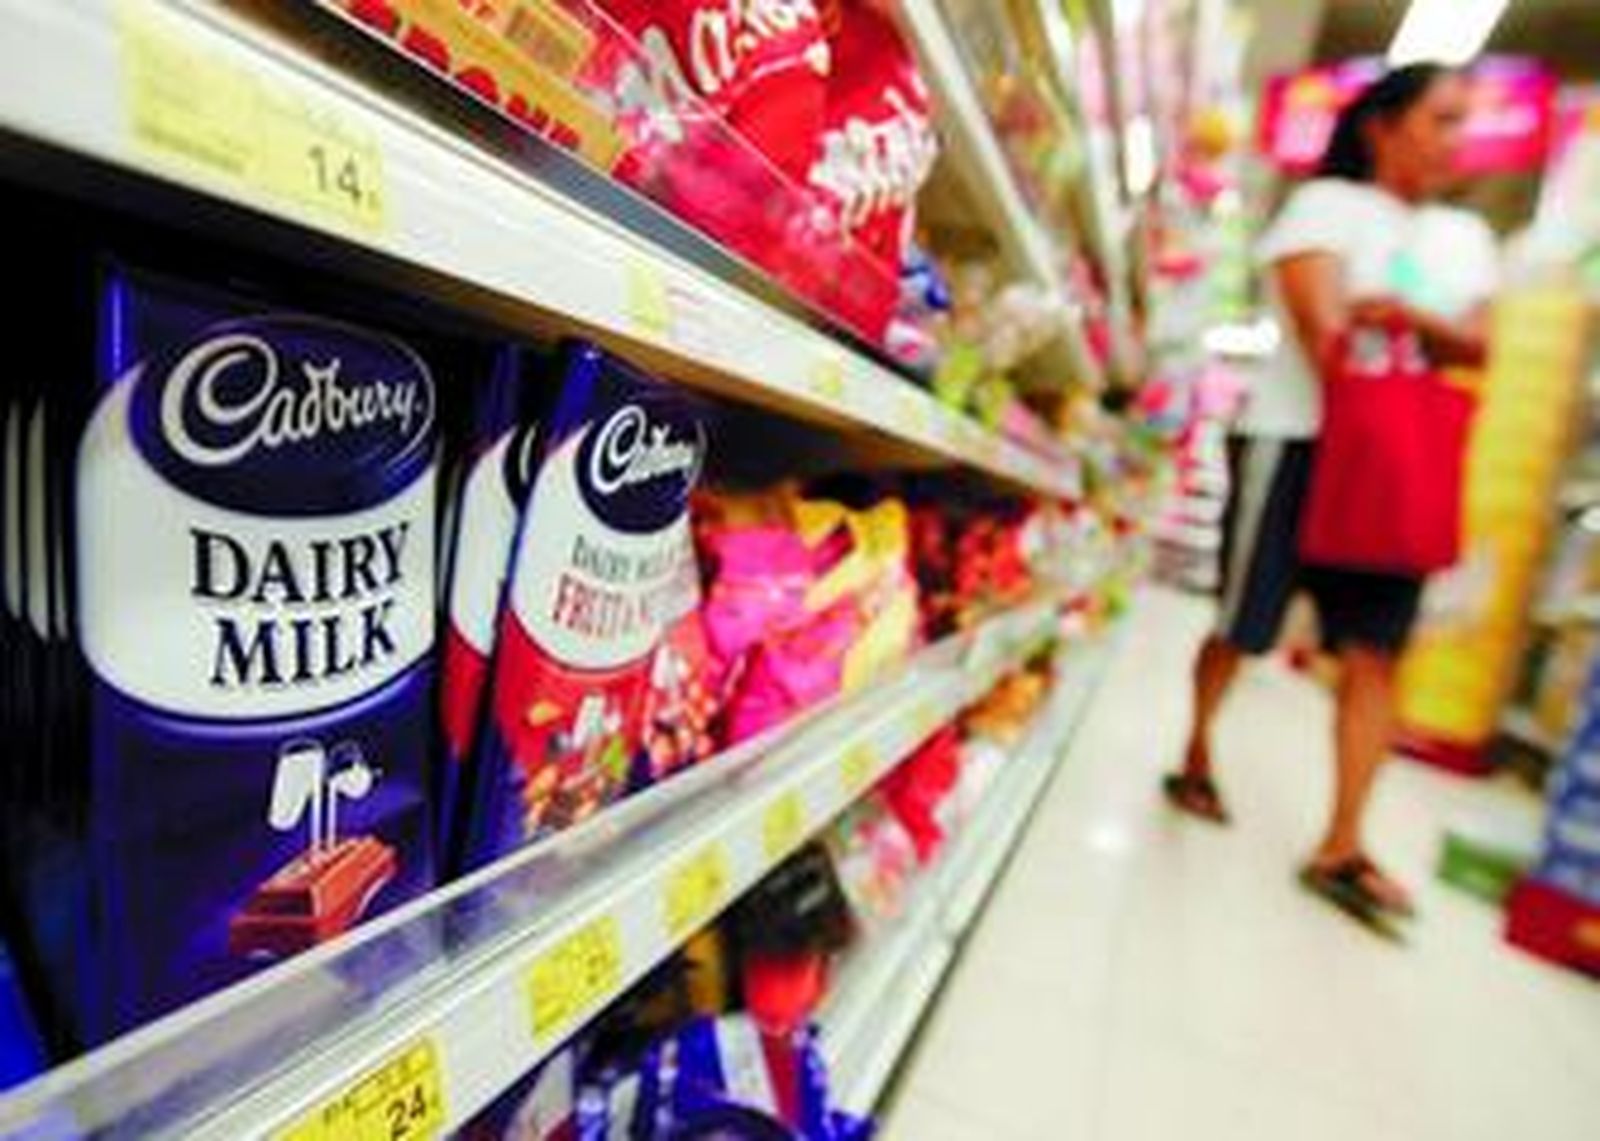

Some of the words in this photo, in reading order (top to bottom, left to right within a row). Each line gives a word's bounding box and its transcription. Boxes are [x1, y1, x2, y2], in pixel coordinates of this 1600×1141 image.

[308, 146, 362, 201] 14
[161, 333, 418, 467] Cadbury
[188, 522, 408, 604] DAIRY
[209, 600, 396, 687] MILK
[385, 1083, 427, 1141] 24
